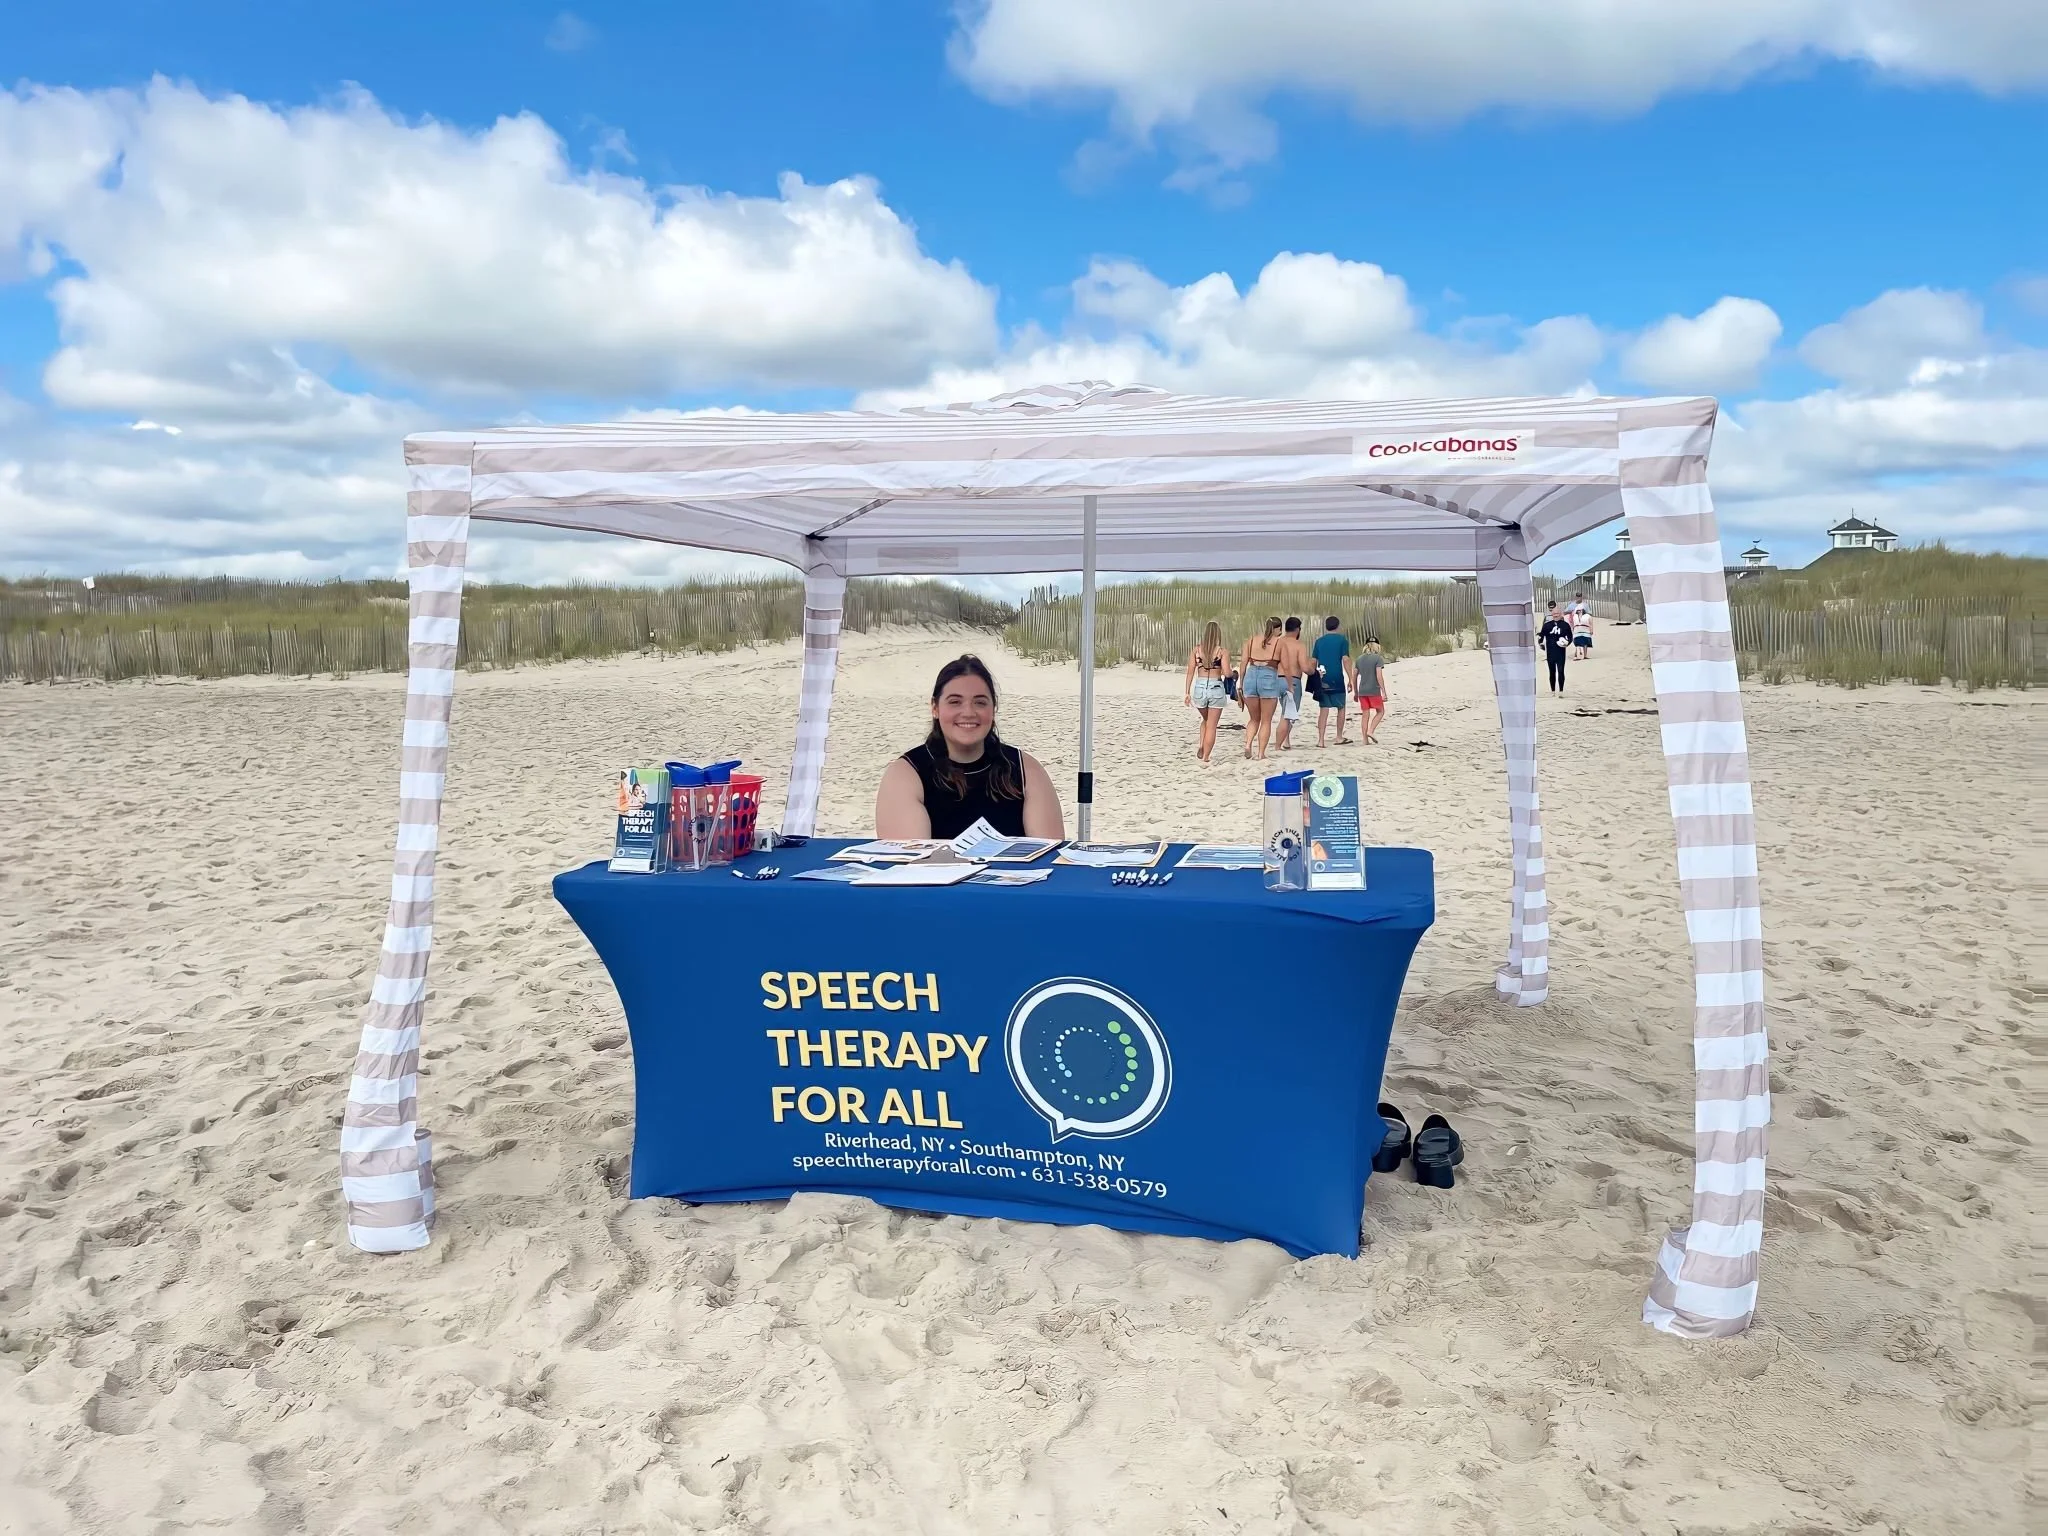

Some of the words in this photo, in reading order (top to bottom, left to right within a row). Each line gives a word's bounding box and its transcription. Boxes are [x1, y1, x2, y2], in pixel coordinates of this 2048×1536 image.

[622, 817, 655, 826] THERAPY
[760, 970, 940, 1012] SPEECH
[766, 1029, 988, 1074] THERAPY
[771, 1086, 869, 1124] FOR
[878, 1088, 964, 1130] ALL
[824, 1132, 918, 1153] Riverhead,
[921, 1137, 945, 1152] NY
[960, 1140, 1094, 1170] Southampton,
[1098, 1153, 1126, 1172] NY
[792, 1153, 1017, 1179] speechtherapyforall.com
[1032, 1166, 1168, 1198] 631-538-0579
